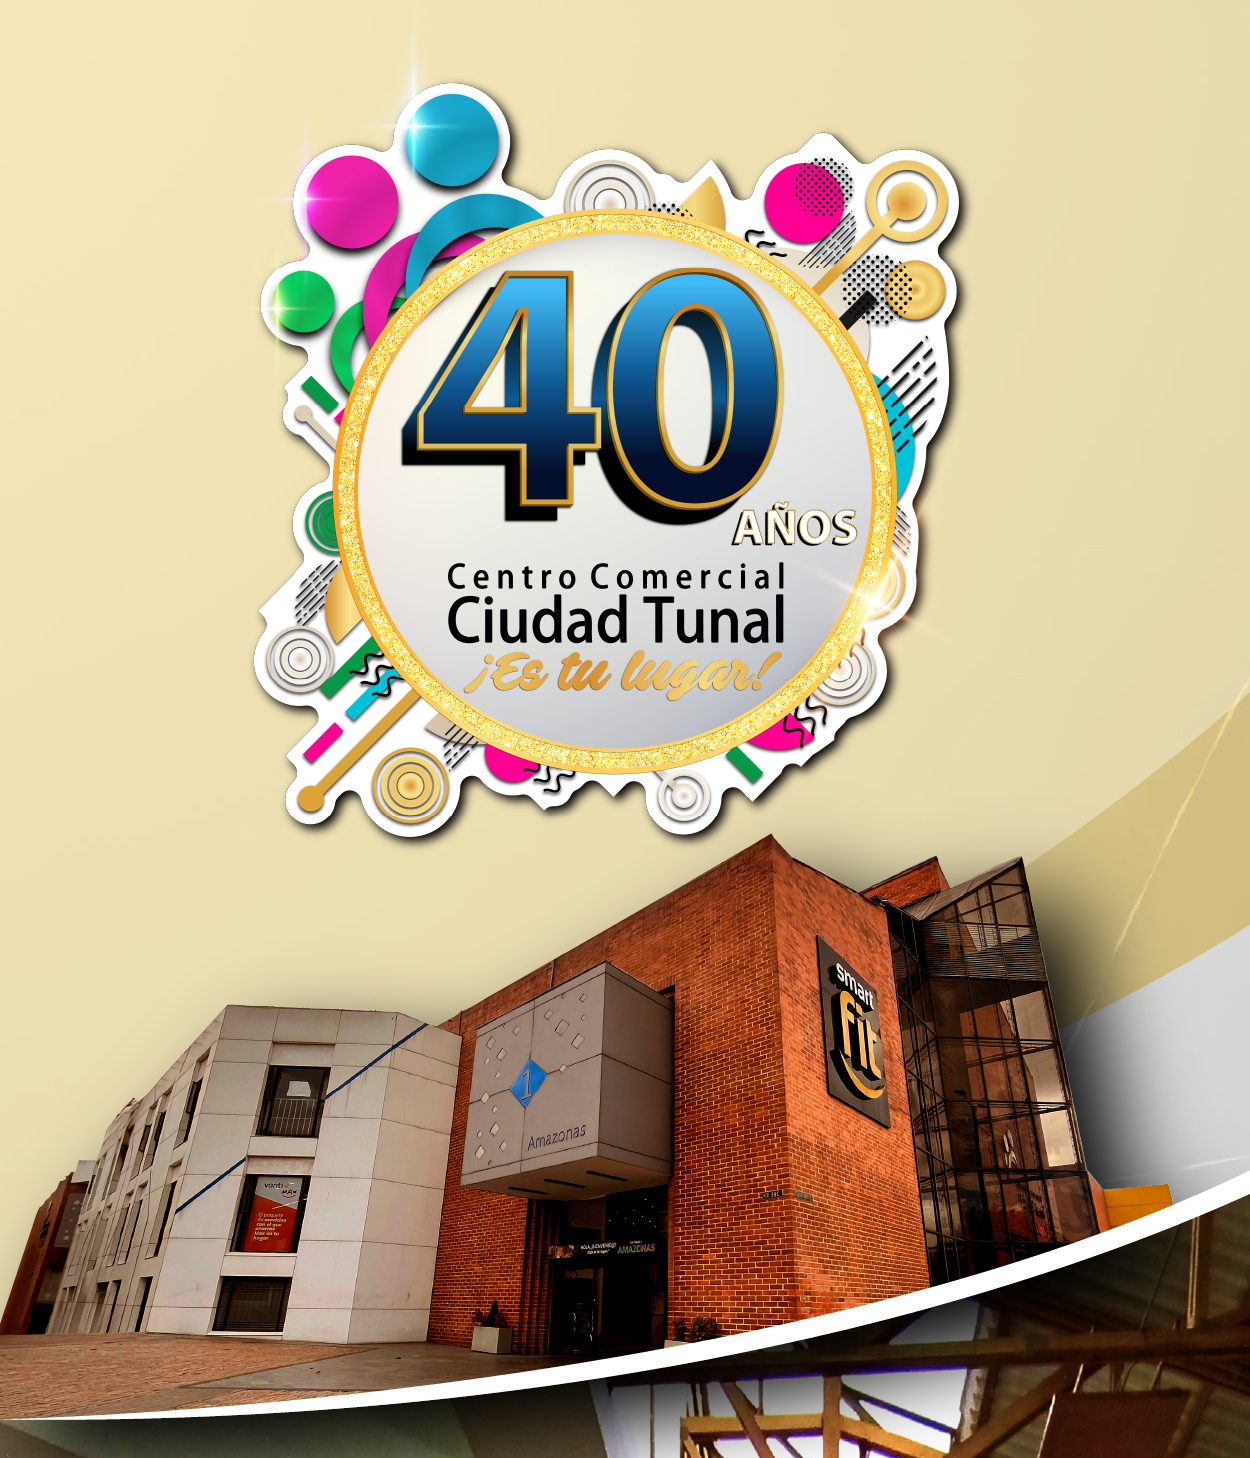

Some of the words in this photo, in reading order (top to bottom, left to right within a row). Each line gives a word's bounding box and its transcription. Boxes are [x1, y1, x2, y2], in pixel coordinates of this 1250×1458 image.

[835, 962, 875, 1010] smart
[839, 990, 882, 1080] fit
[522, 1067, 534, 1101] 1
[527, 1124, 587, 1151] Amazonas
[617, 1243, 656, 1254] AMAZONAS
